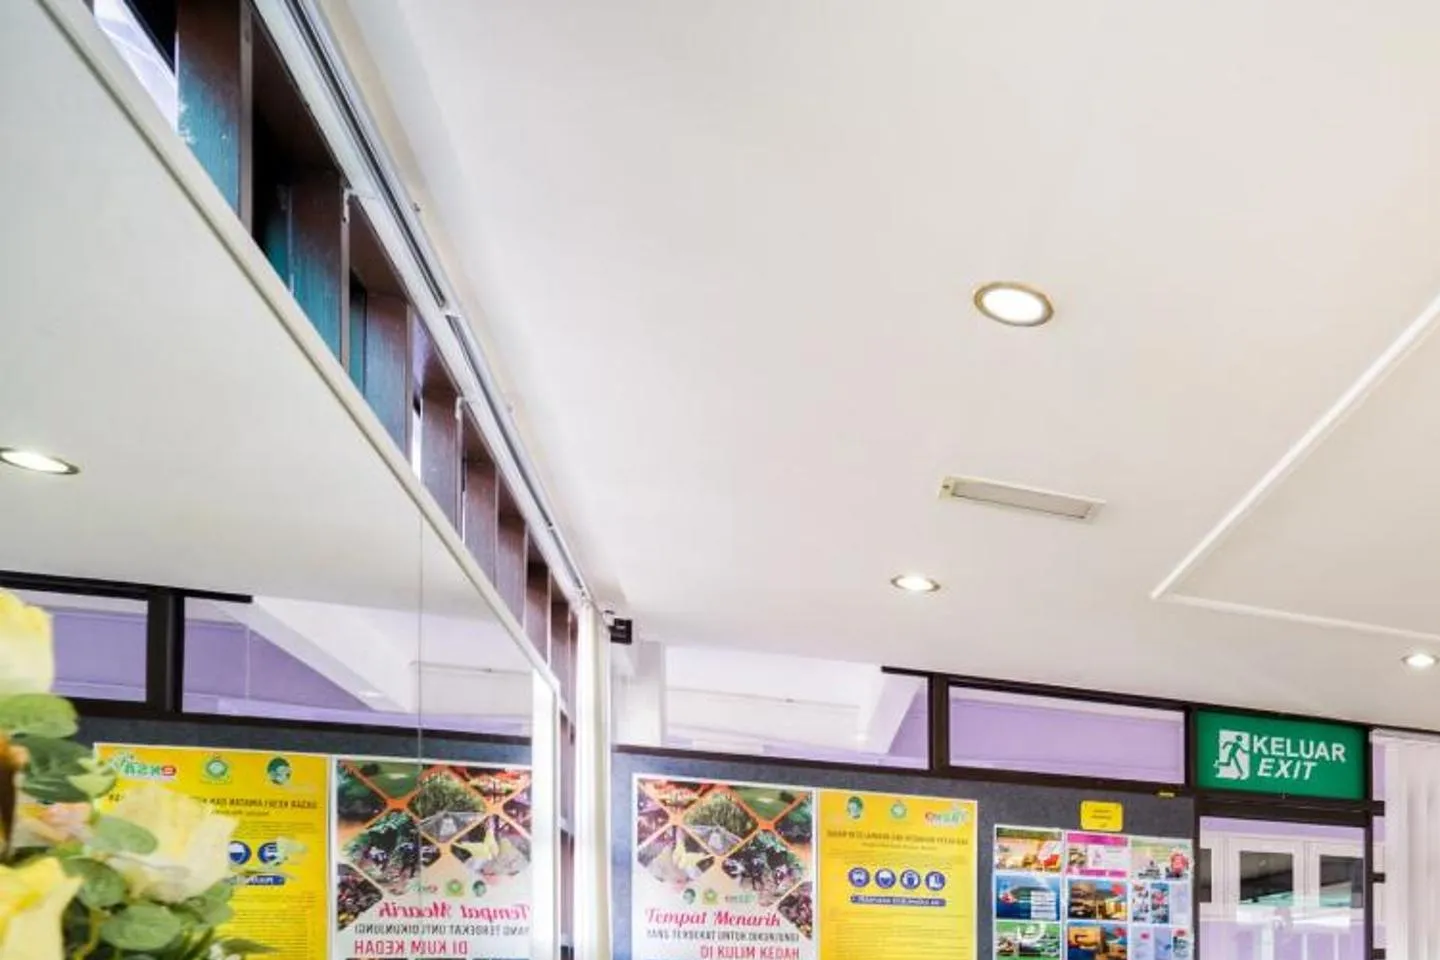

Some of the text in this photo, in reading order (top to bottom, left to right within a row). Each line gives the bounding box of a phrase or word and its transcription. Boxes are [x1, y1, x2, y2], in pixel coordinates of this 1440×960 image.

[1253, 735, 1346, 762] KELUAR
[1257, 757, 1318, 780] EXIT
[645, 908, 781, 928] Tempat Menarik
[701, 945, 800, 960] DI KULIM KEDAH
